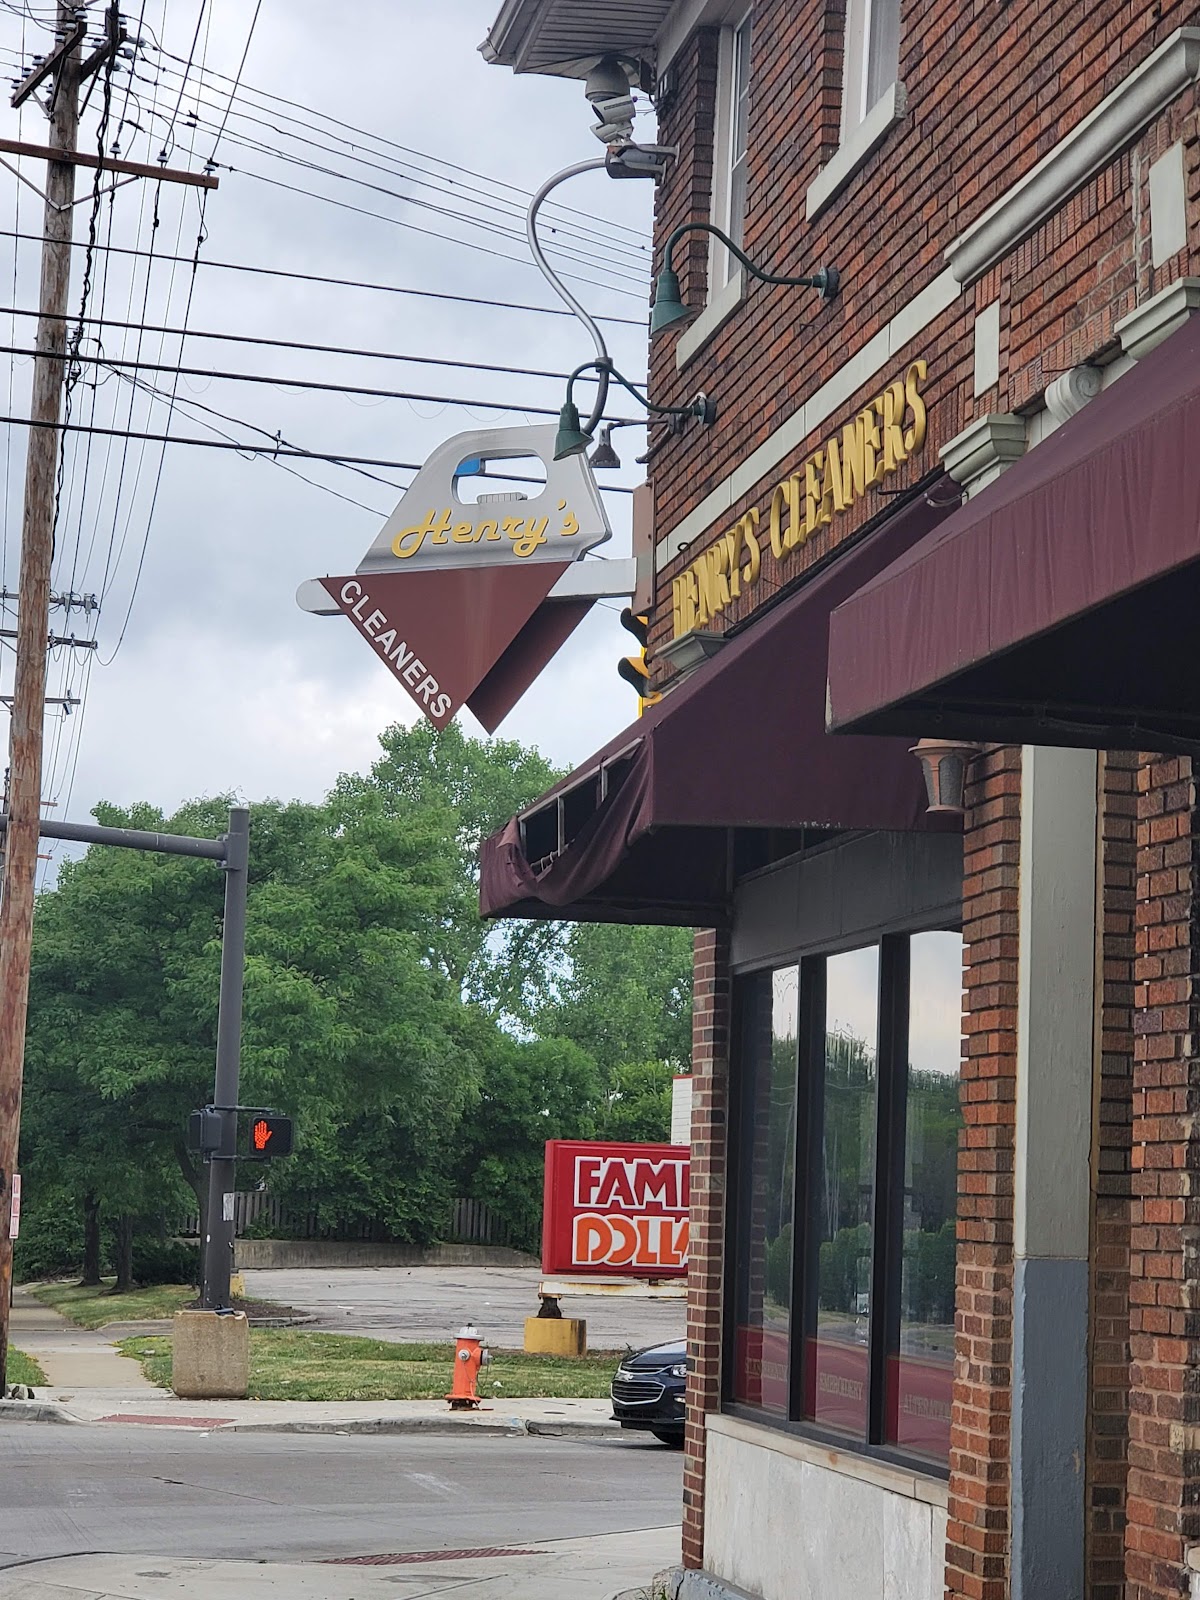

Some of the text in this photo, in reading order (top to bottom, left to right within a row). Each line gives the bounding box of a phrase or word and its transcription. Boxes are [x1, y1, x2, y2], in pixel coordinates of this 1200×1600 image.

[391, 500, 580, 558] Henry's
[673, 359, 927, 639] HENRY'S CLEANERS
[340, 580, 452, 718] CLEANERS
